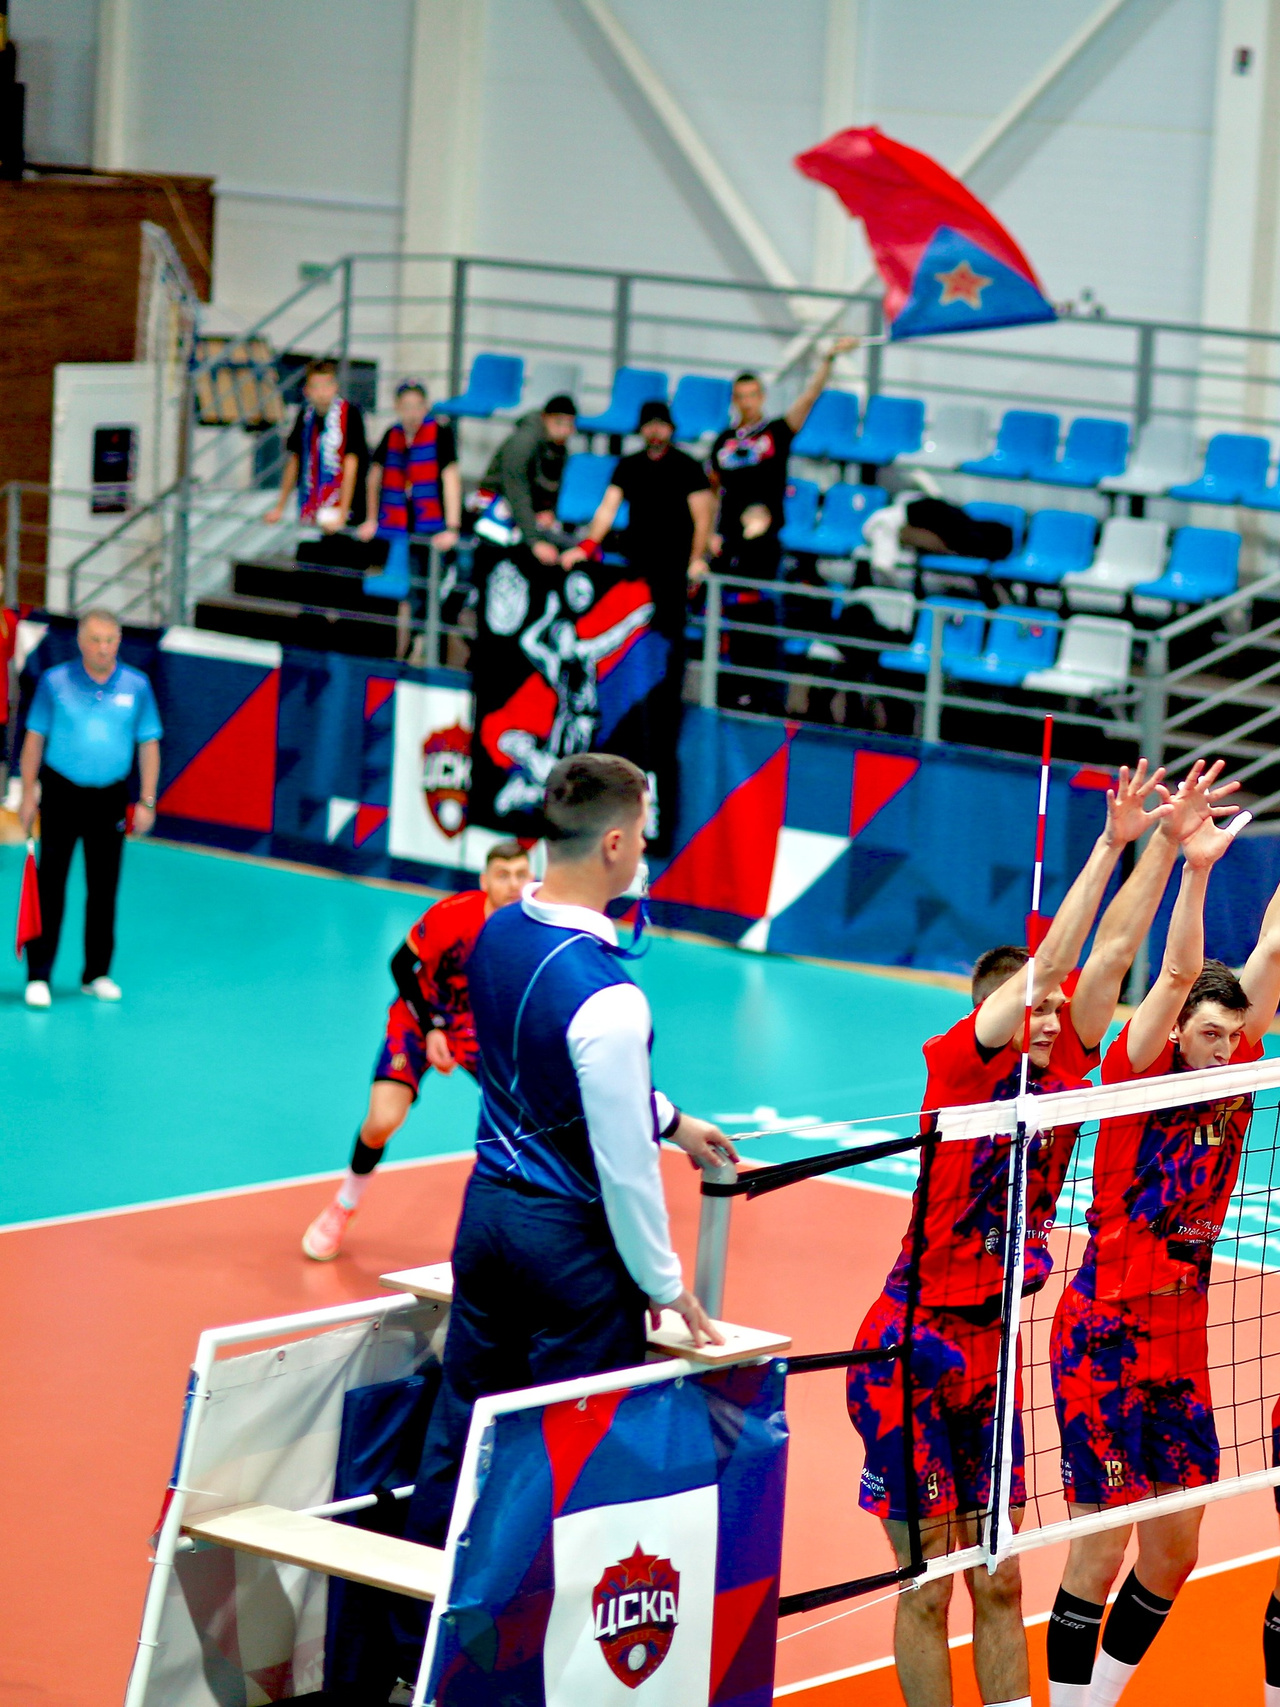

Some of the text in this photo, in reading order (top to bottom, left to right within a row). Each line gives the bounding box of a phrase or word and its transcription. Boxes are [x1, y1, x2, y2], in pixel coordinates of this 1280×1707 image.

[422, 751, 472, 792] ЦСК
[927, 1472, 939, 1500] 9
[594, 1590, 679, 1640] ЦСКА
